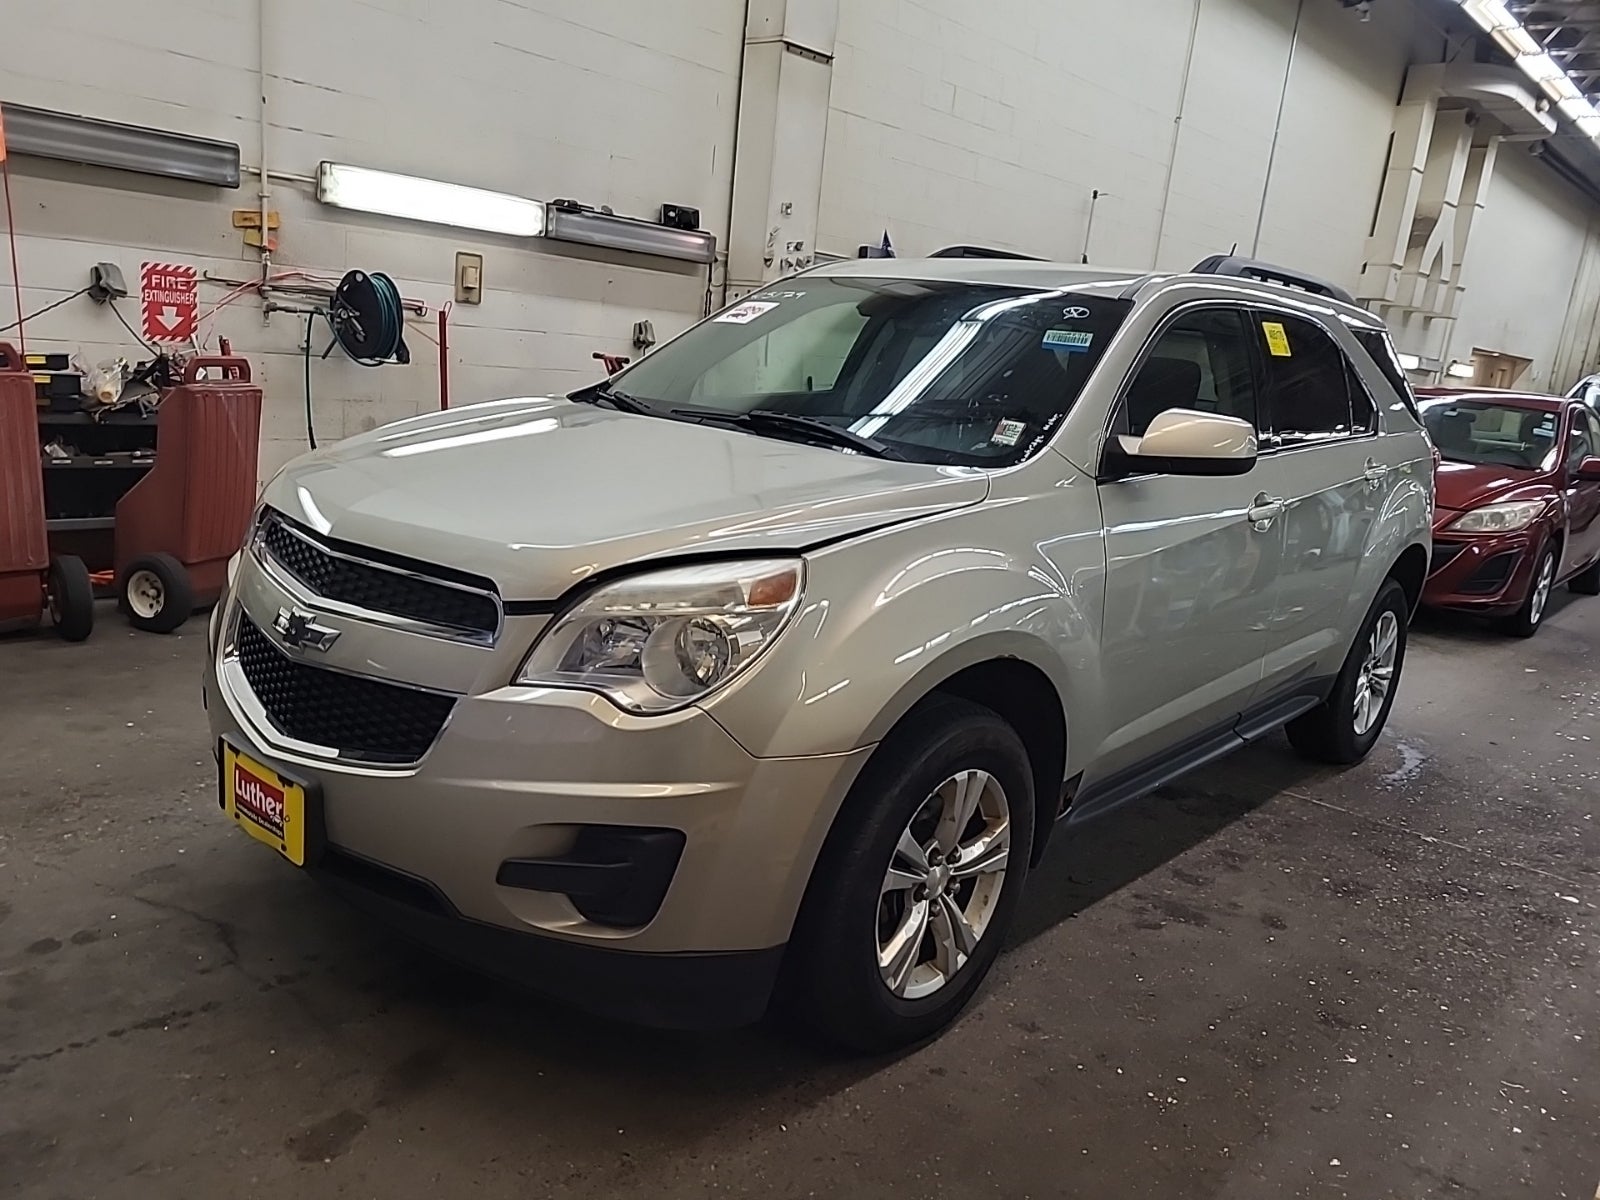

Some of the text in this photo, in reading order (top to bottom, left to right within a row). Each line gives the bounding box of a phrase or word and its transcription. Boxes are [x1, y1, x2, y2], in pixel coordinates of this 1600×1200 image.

[152, 275, 188, 290] FIRE
[144, 289, 195, 305] EXTINGUISHER
[235, 769, 283, 816] Luther
